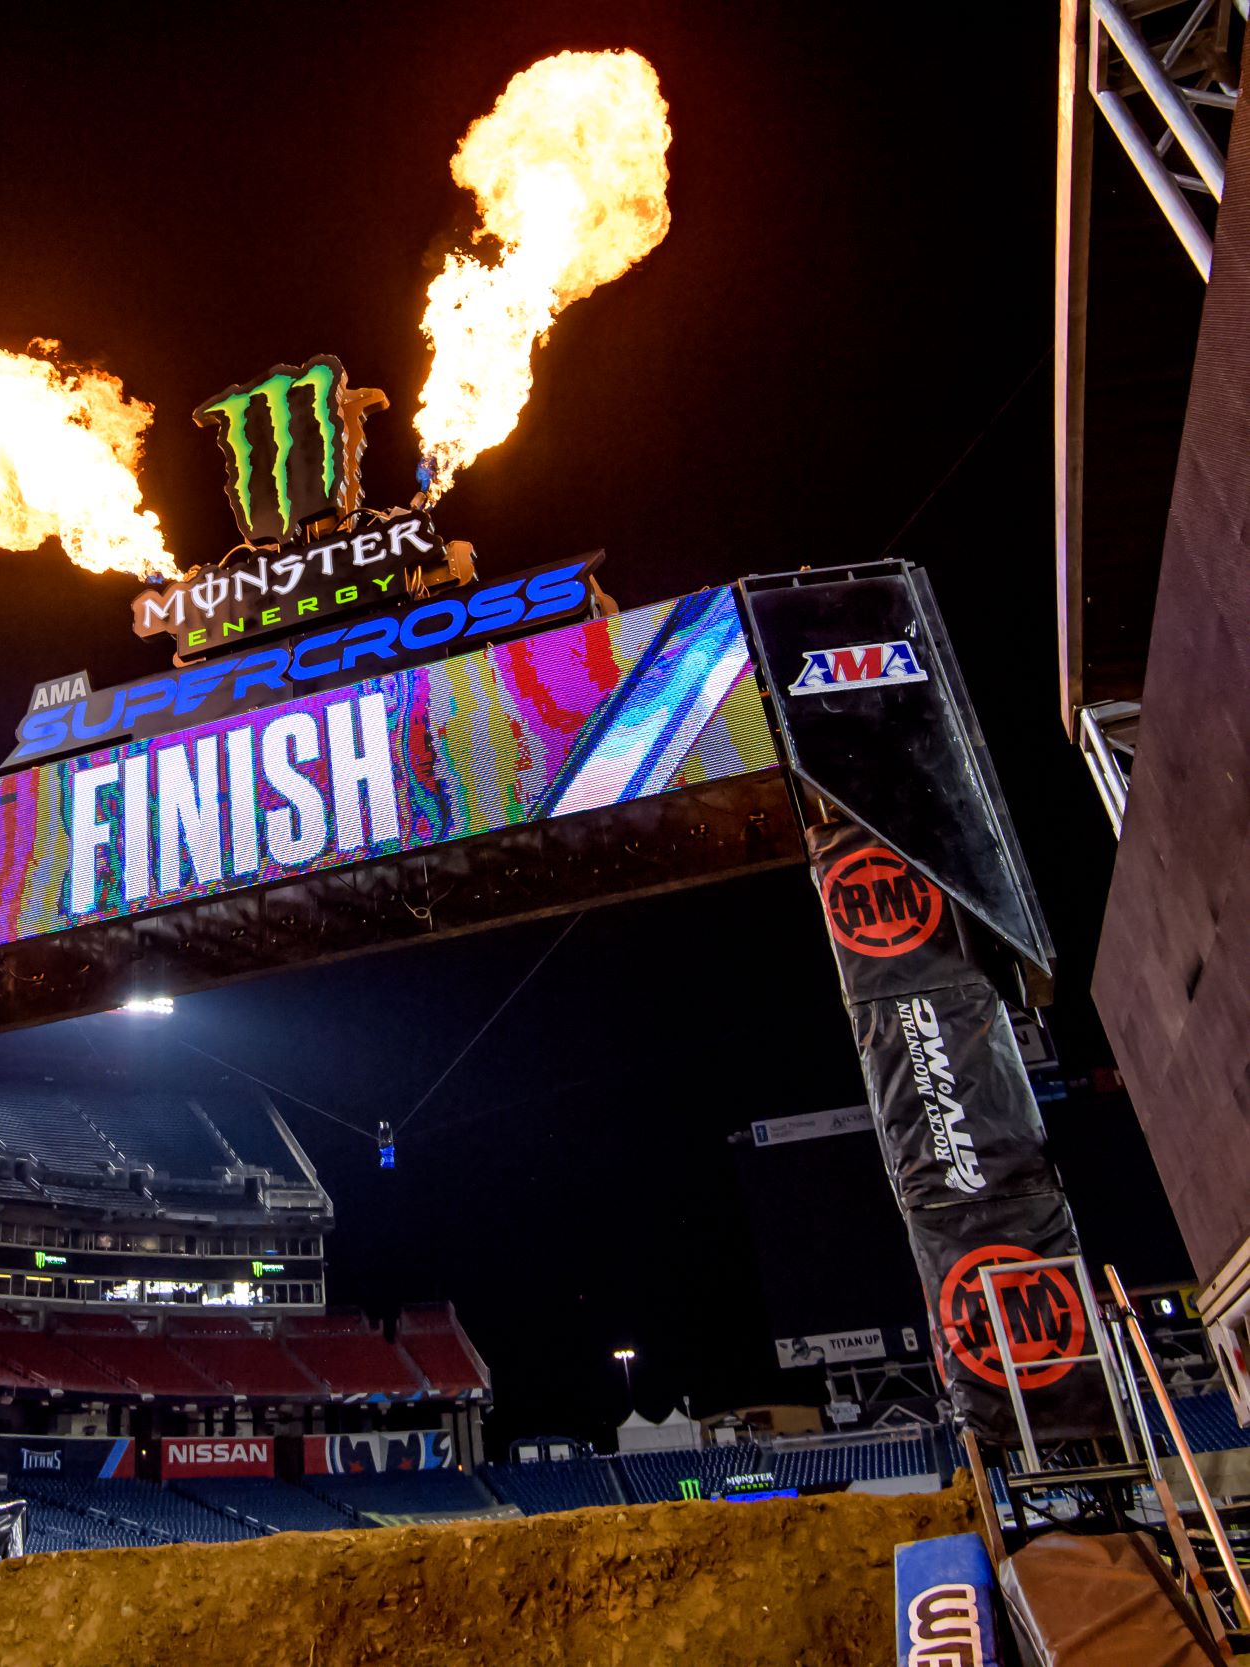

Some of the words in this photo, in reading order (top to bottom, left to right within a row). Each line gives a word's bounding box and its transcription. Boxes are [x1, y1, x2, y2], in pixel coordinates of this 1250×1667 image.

[142, 518, 434, 627] MONSTER
[188, 574, 395, 647] ENERGY
[14, 562, 587, 759] SUPERCROSS
[789, 641, 928, 692] AMA
[33, 677, 87, 710] AMA
[71, 693, 400, 915] FINISH
[840, 877, 916, 928] RM
[896, 1001, 935, 1098] MOUNTAIN
[923, 1100, 954, 1163] ROCKY
[830, 1337, 863, 1350] TITAN
[865, 1334, 880, 1346] UP
[21, 1447, 62, 1470] TITANS
[167, 1443, 268, 1464] NISSAN
[726, 1472, 775, 1486] MONSTER
[908, 1584, 984, 1667] WP
